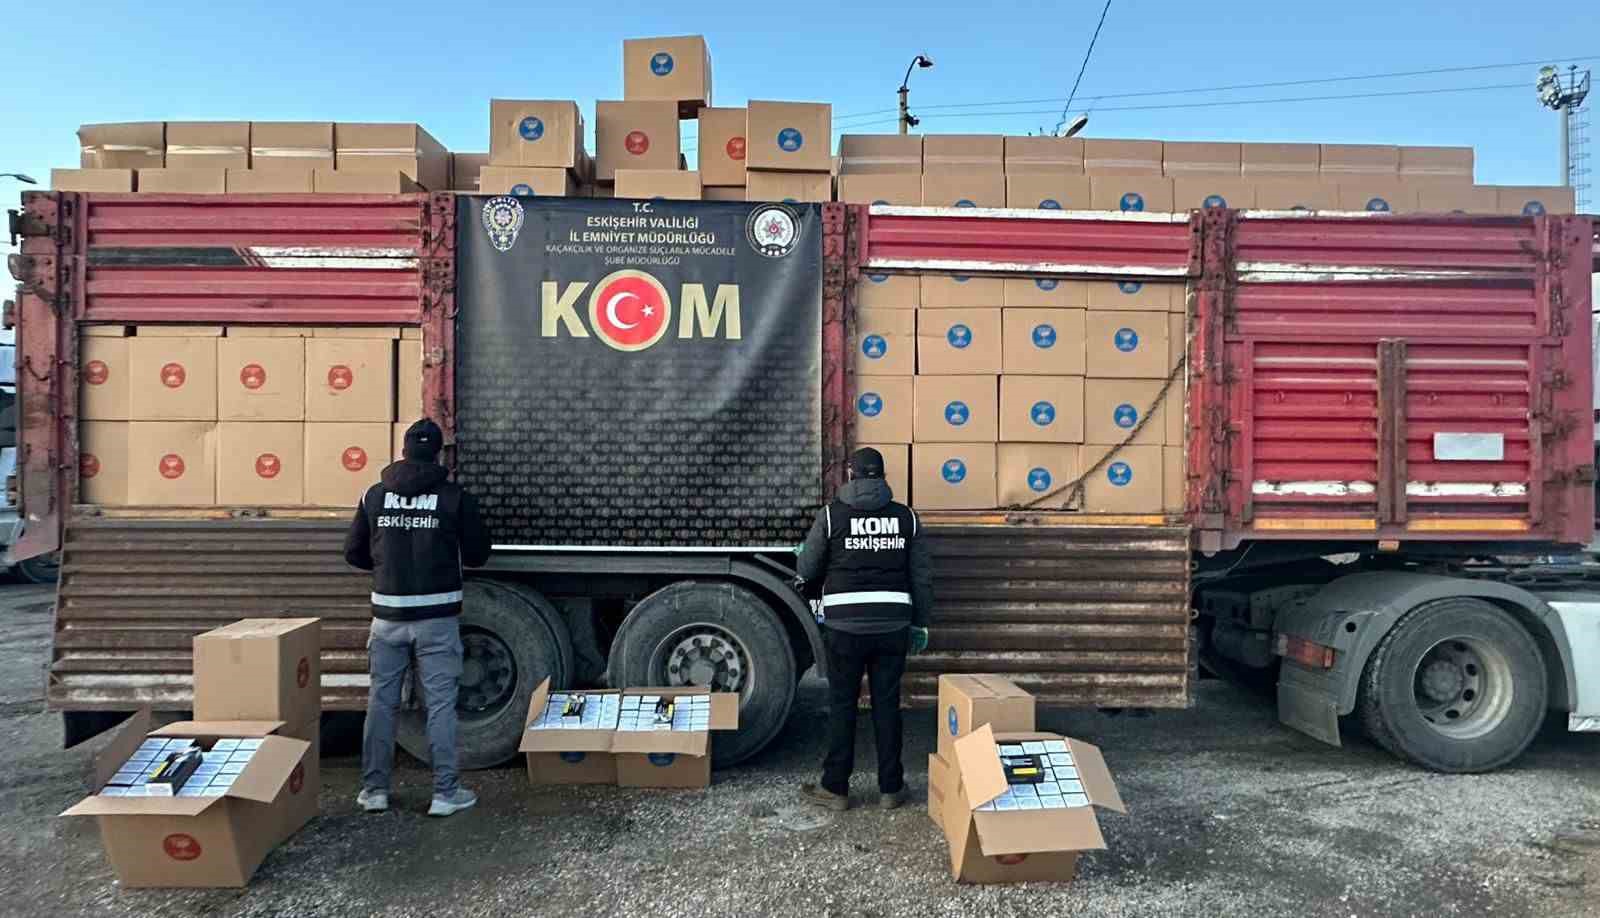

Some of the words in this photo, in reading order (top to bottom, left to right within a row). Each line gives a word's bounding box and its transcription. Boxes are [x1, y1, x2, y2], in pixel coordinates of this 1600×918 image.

[632, 202, 654, 213] T.C.
[586, 216, 647, 230] ESKİŞEHİR
[650, 216, 699, 229] VALİLİĞİ
[569, 230, 580, 242] İL
[582, 230, 635, 243] EMNİYET
[637, 231, 715, 244] MÜDÜRLÜĞÜ
[377, 514, 440, 530] ESKİŞEHİR
[850, 517, 900, 536] KOM
[845, 535, 906, 552] ESKİŞEHİR
